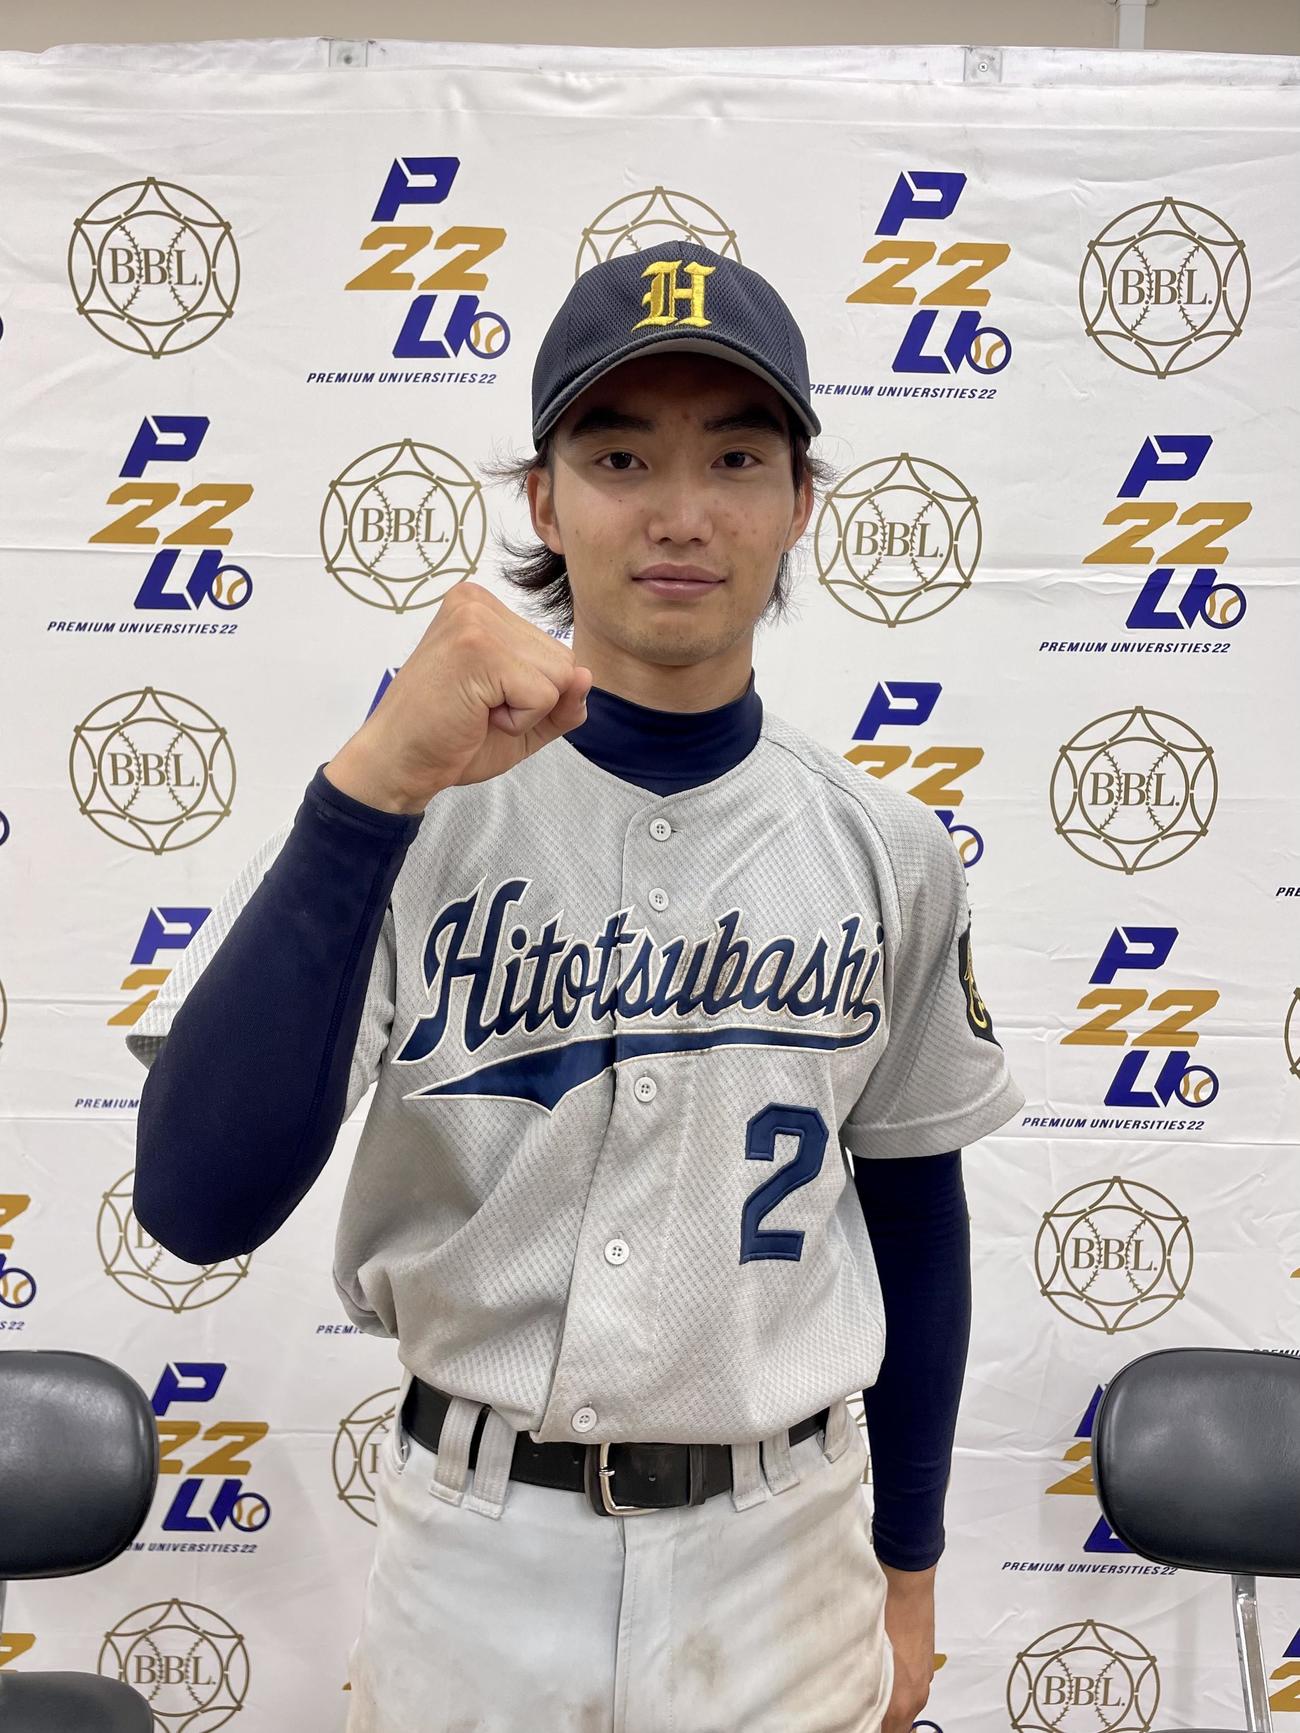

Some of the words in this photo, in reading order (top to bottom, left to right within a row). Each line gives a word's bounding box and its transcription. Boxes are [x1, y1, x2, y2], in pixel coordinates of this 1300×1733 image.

[371, 157, 460, 222] P
[874, 171, 967, 236] P
[344, 226, 507, 291] 22
[845, 240, 1011, 307] 22
[631, 260, 716, 332] H
[307, 372, 375, 383] PREMIUM
[118, 415, 210, 477] P
[1116, 435, 1213, 498] P
[88, 482, 254, 545] 22
[1082, 502, 1252, 565] 22
[47, 621, 116, 632] PREMIUM
[1039, 641, 1108, 653] PREMIUM
[852, 681, 942, 741] P
[391, 874, 889, 1064] Hitotsubashi
[1089, 927, 1179, 985] P
[1060, 988, 1220, 1047] 22
[1022, 1117, 1087, 1128] PREMIUM
[739, 1102, 829, 1265] 2
[152, 1363, 226, 1416] P
[1001, 1562, 1065, 1573] PREMIUM
